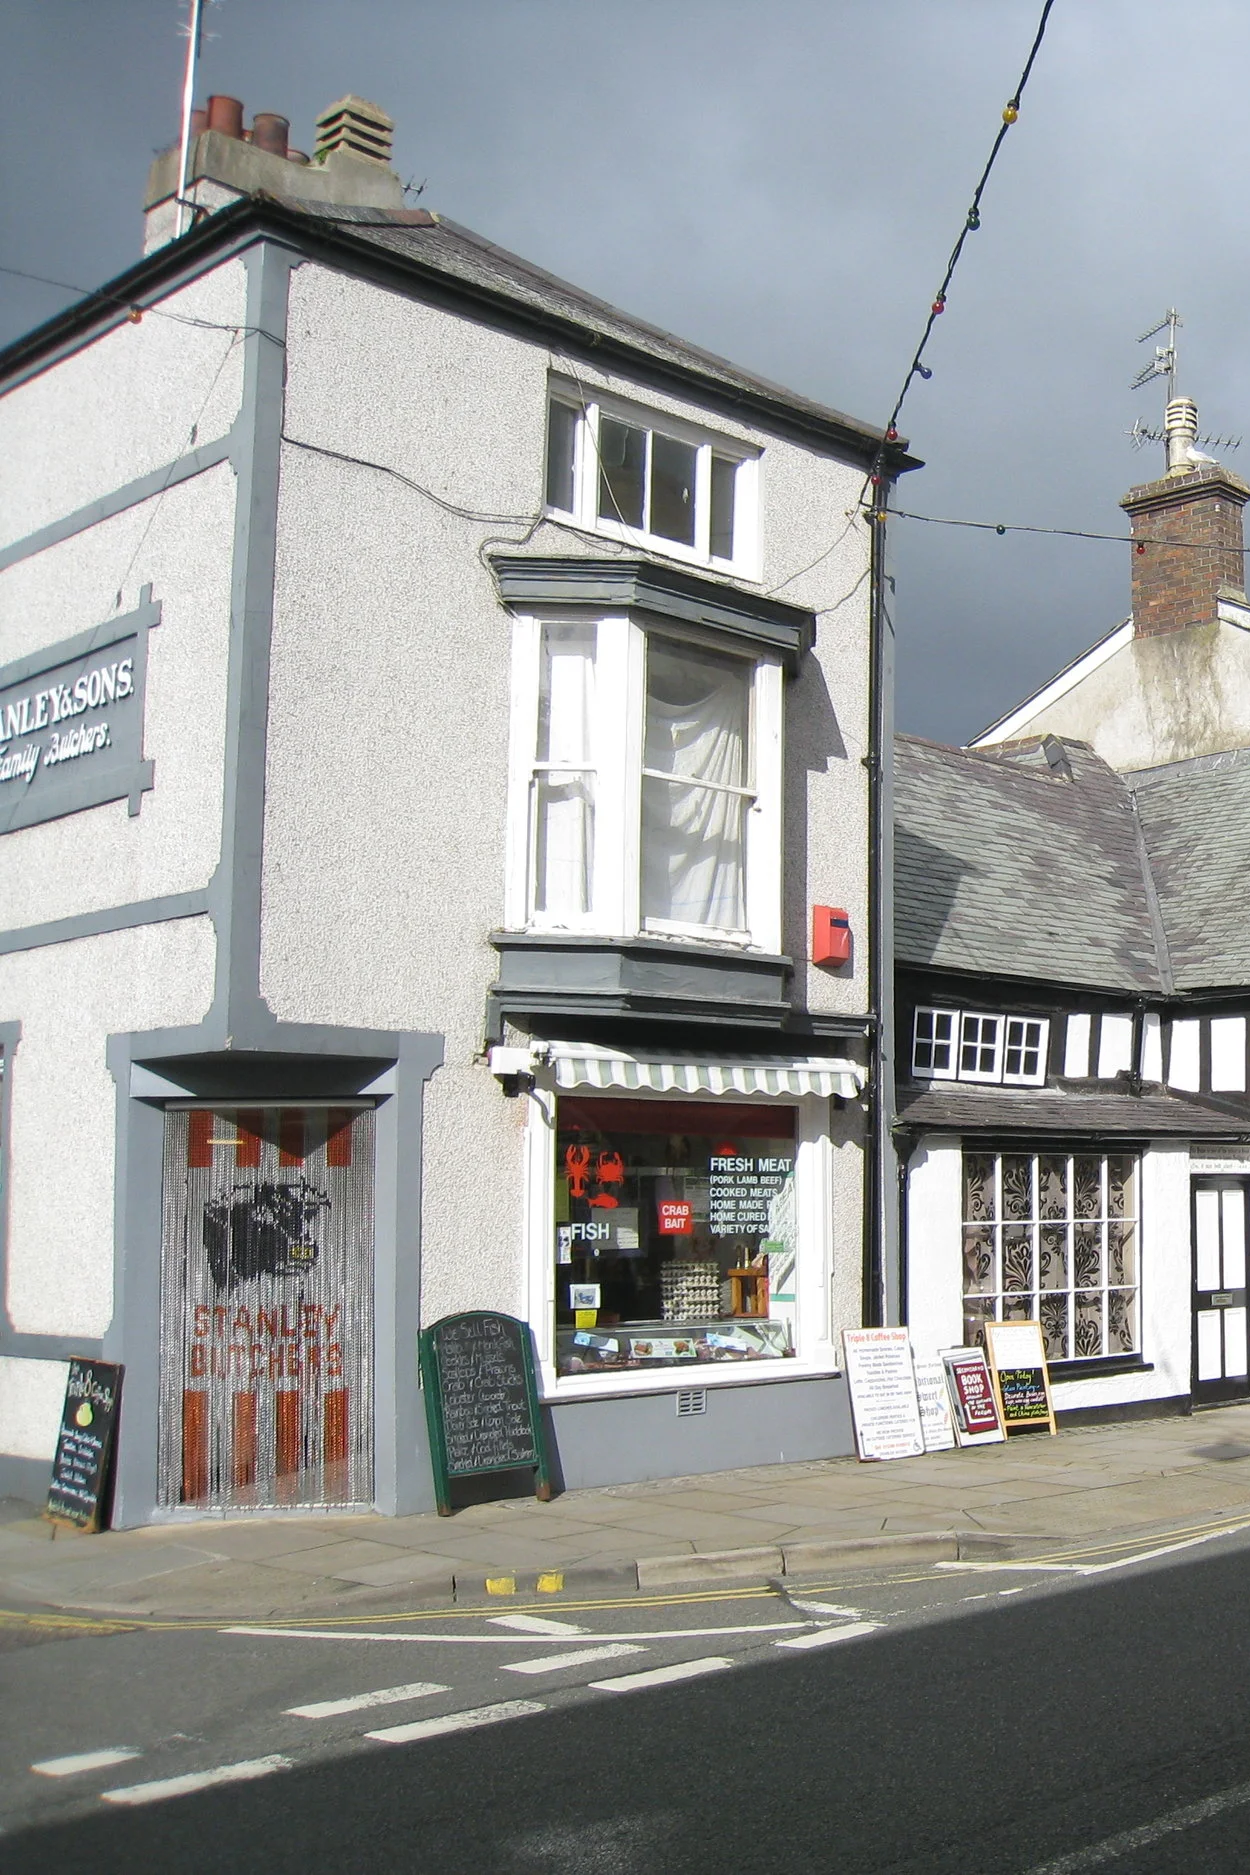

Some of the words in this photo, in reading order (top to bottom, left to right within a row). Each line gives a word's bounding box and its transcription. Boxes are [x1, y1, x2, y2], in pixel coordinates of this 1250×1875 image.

[710, 1157, 754, 1172] FRESH
[758, 1158, 792, 1172] MEAT
[709, 1175, 735, 1185] (PORK
[736, 1175, 758, 1185] LAMB
[760, 1176, 782, 1185] BEEF)
[709, 1187, 747, 1198] COOKED
[750, 1188, 778, 1198] MEATS
[662, 1204, 690, 1216] CRAB
[710, 1200, 736, 1210] HOME
[739, 1200, 764, 1210] MADE
[710, 1211, 736, 1222] HOME
[737, 1211, 767, 1222] CURED
[664, 1217, 687, 1229] BAIT
[710, 1224, 745, 1234] VARIETY
[746, 1224, 758, 1234] OF
[571, 1222, 610, 1240] FISH
[194, 1304, 341, 1338] STANLEY
[483, 1318, 507, 1338] Fish
[847, 1333, 865, 1344] Triple
[871, 1332, 890, 1342] Coffee
[891, 1331, 906, 1343] Shop
[191, 1343, 342, 1379] BUTCHERS
[960, 1373, 983, 1386] BOOK
[963, 1384, 985, 1395] SHOP
